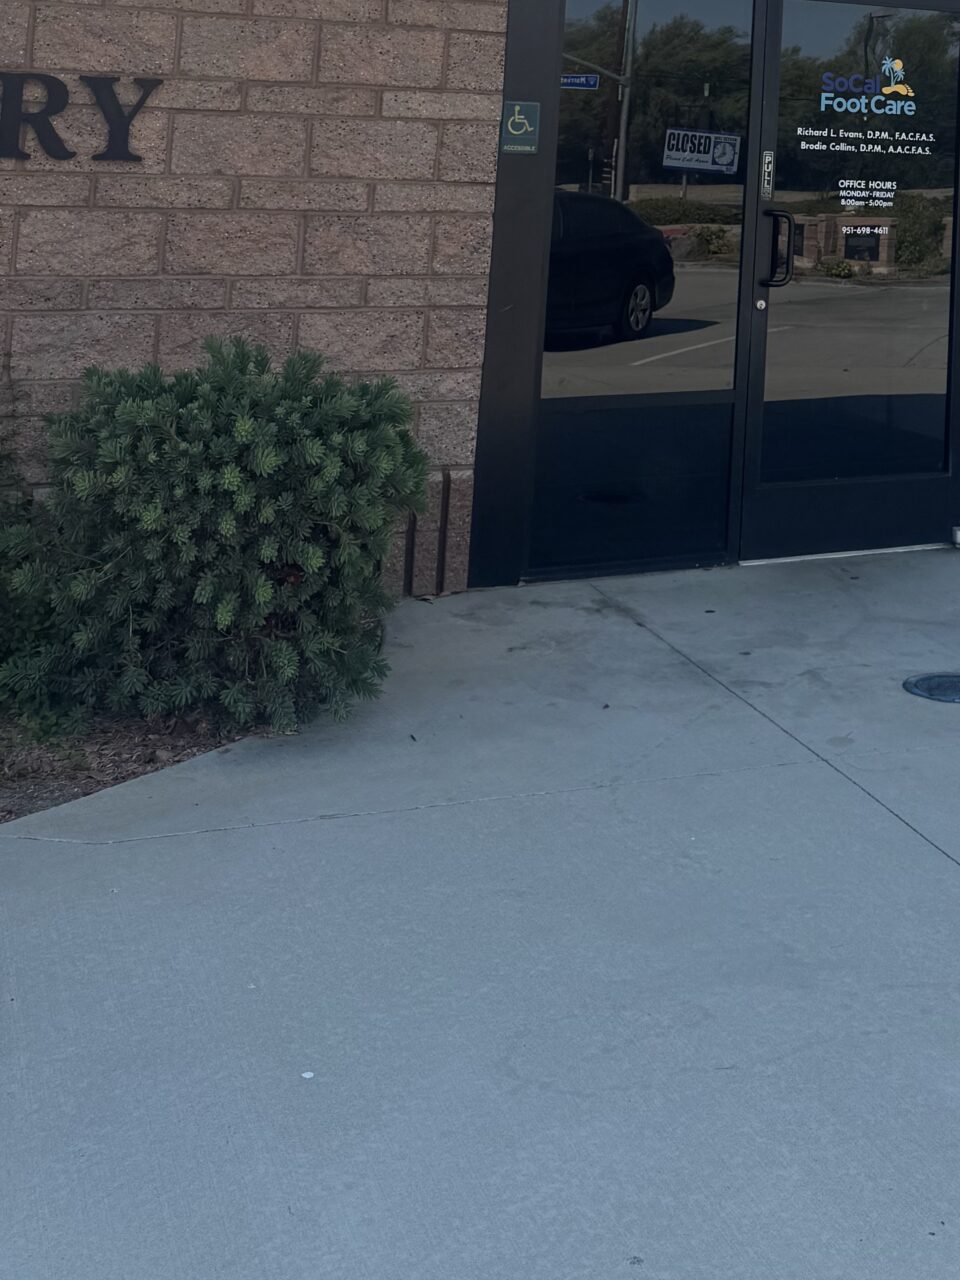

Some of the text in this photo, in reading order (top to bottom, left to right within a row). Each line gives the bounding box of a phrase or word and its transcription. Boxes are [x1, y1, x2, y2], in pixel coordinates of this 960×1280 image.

[822, 72, 881, 94] SoCal
[820, 92, 917, 116] Foot Care
[0, 73, 164, 162] RY
[667, 131, 712, 155] CLOSED
[797, 127, 828, 137] Richard
[839, 129, 865, 139] Evans,
[800, 141, 827, 151] Brodie
[829, 142, 858, 153] Collins,
[764, 156, 772, 188] PULL
[838, 180, 897, 190] OFFICE HOURS
[841, 226, 889, 234] 951-698-4611
